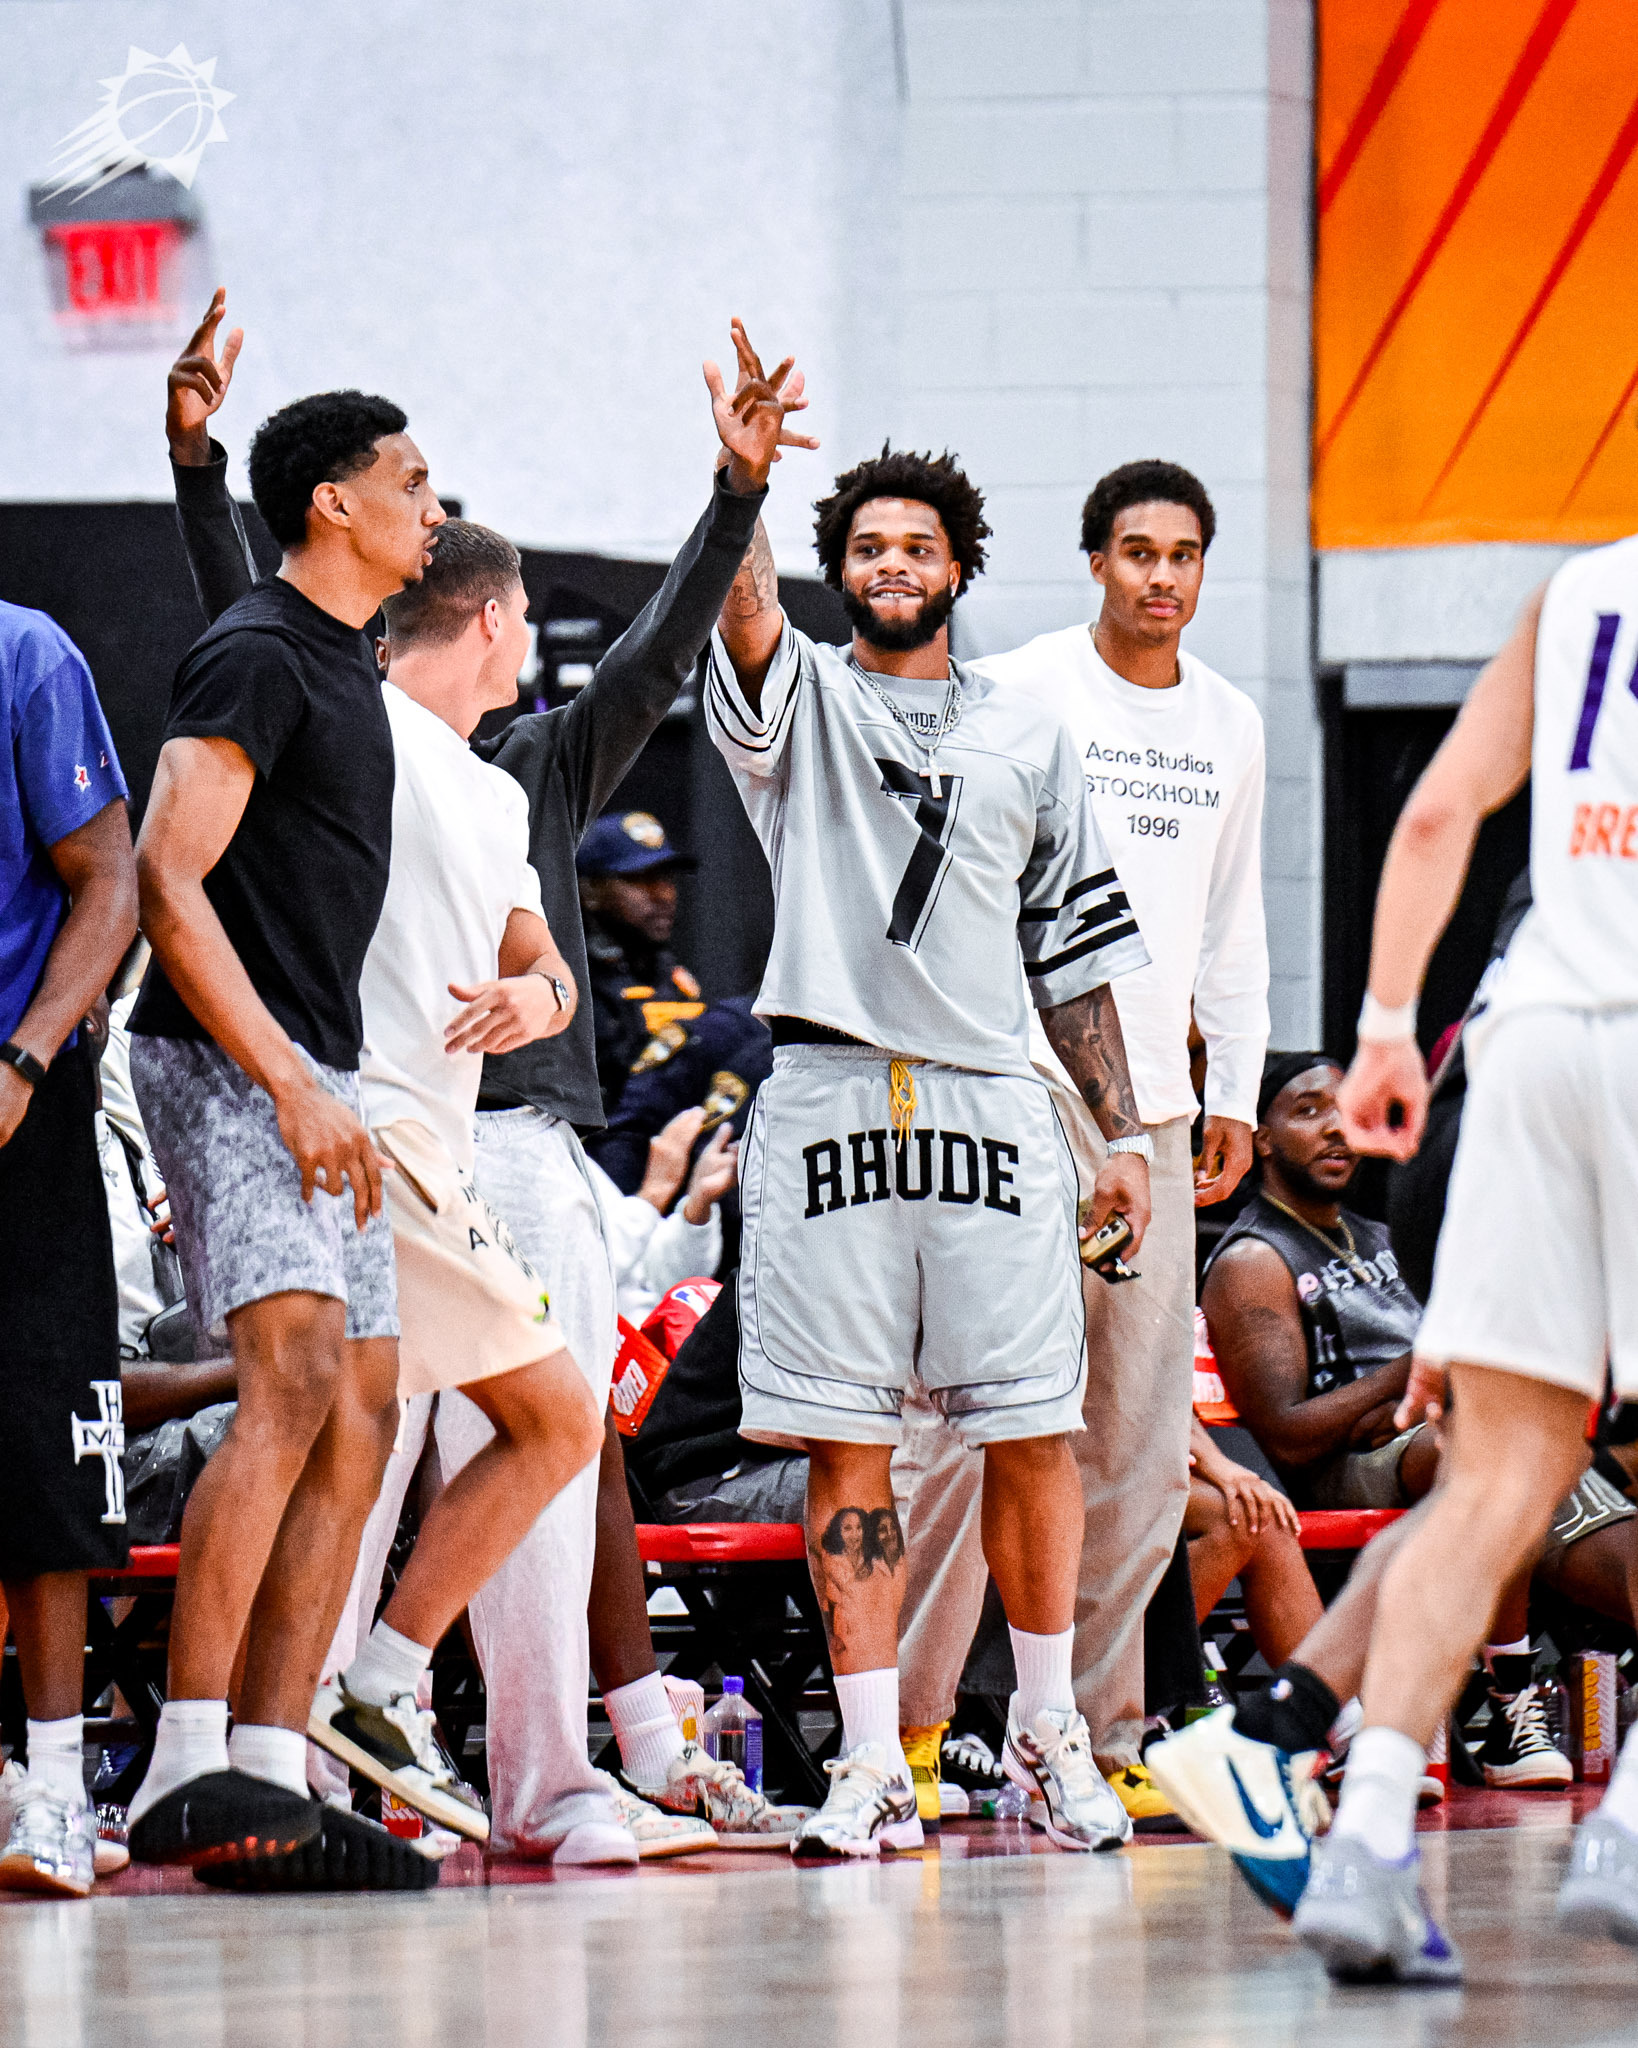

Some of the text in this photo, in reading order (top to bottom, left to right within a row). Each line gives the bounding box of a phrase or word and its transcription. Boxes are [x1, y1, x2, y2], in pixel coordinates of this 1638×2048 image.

[1570, 614, 1638, 770] 1
[1086, 741, 1213, 774] Acne Studios
[1085, 774, 1219, 808] STOCKHOLM
[874, 757, 964, 953] 7
[1127, 814, 1180, 839] 1996
[802, 1128, 1021, 1219] RHUDE
